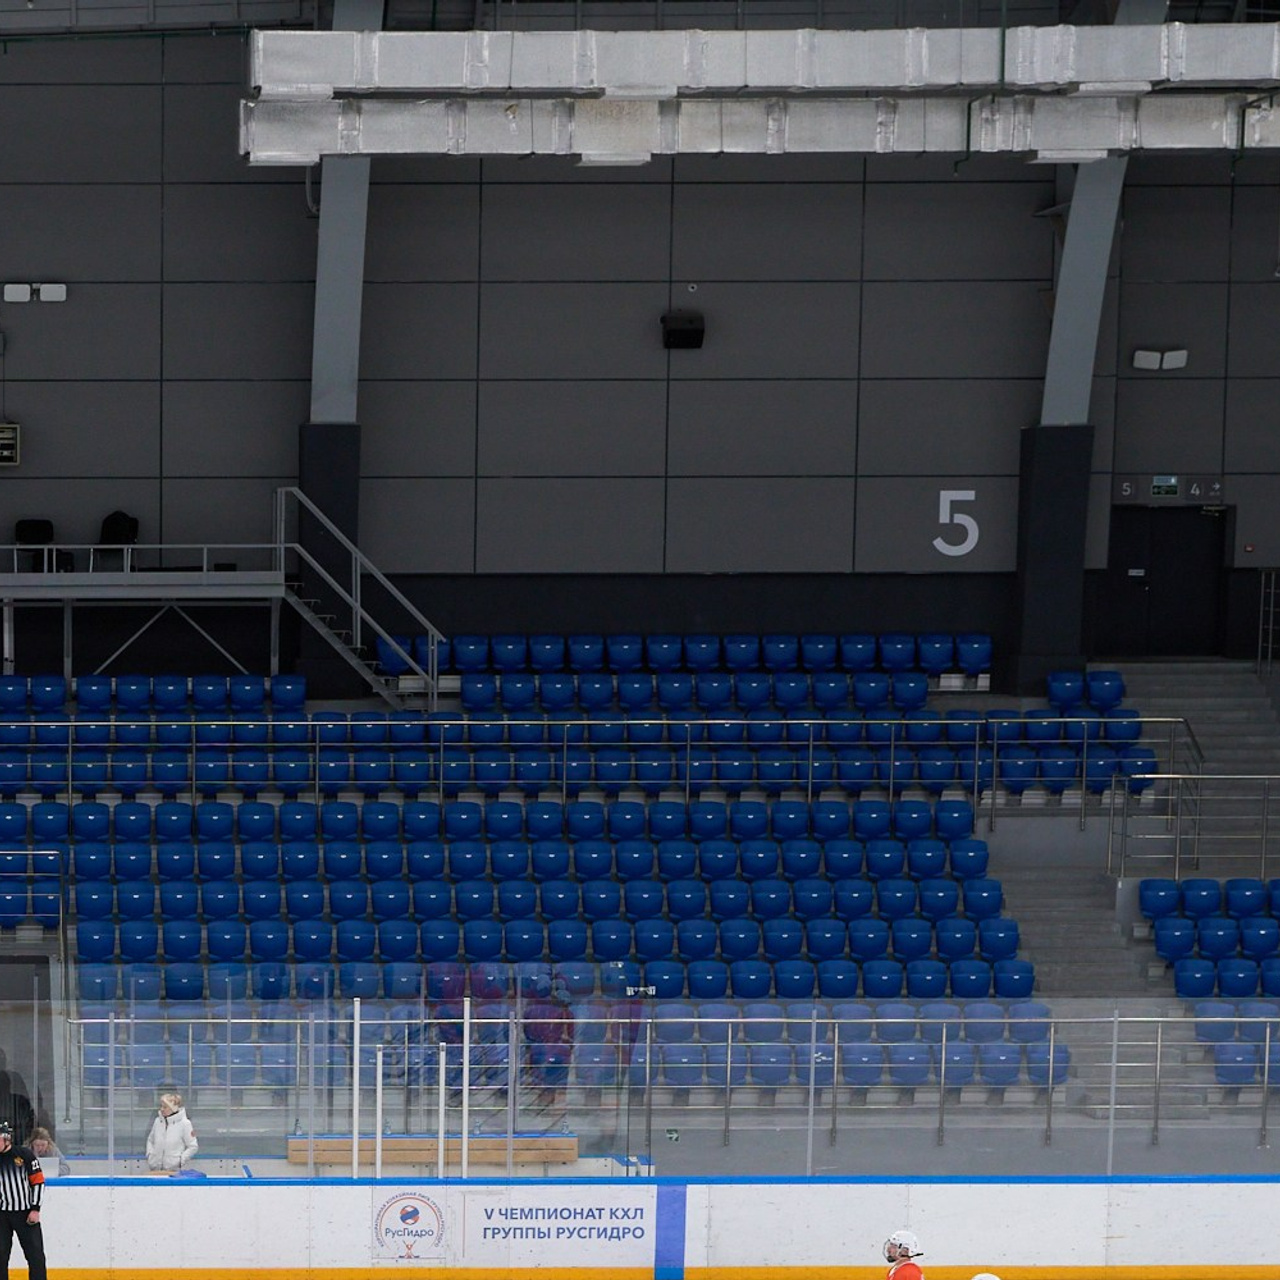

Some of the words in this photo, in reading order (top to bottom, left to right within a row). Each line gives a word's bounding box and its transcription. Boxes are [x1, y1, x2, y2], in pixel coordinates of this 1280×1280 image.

[1122, 482, 1131, 495] 5
[1190, 483, 1200, 496] 4
[932, 490, 979, 556] 5
[484, 1208, 494, 1220] V
[498, 1207, 605, 1220] ЧЕМПИОНАТ
[610, 1208, 644, 1220] КХЛ
[385, 1227, 434, 1239] РусГидро
[483, 1227, 551, 1239] ГРУППЫ
[556, 1227, 645, 1241] РУСГИДРО
